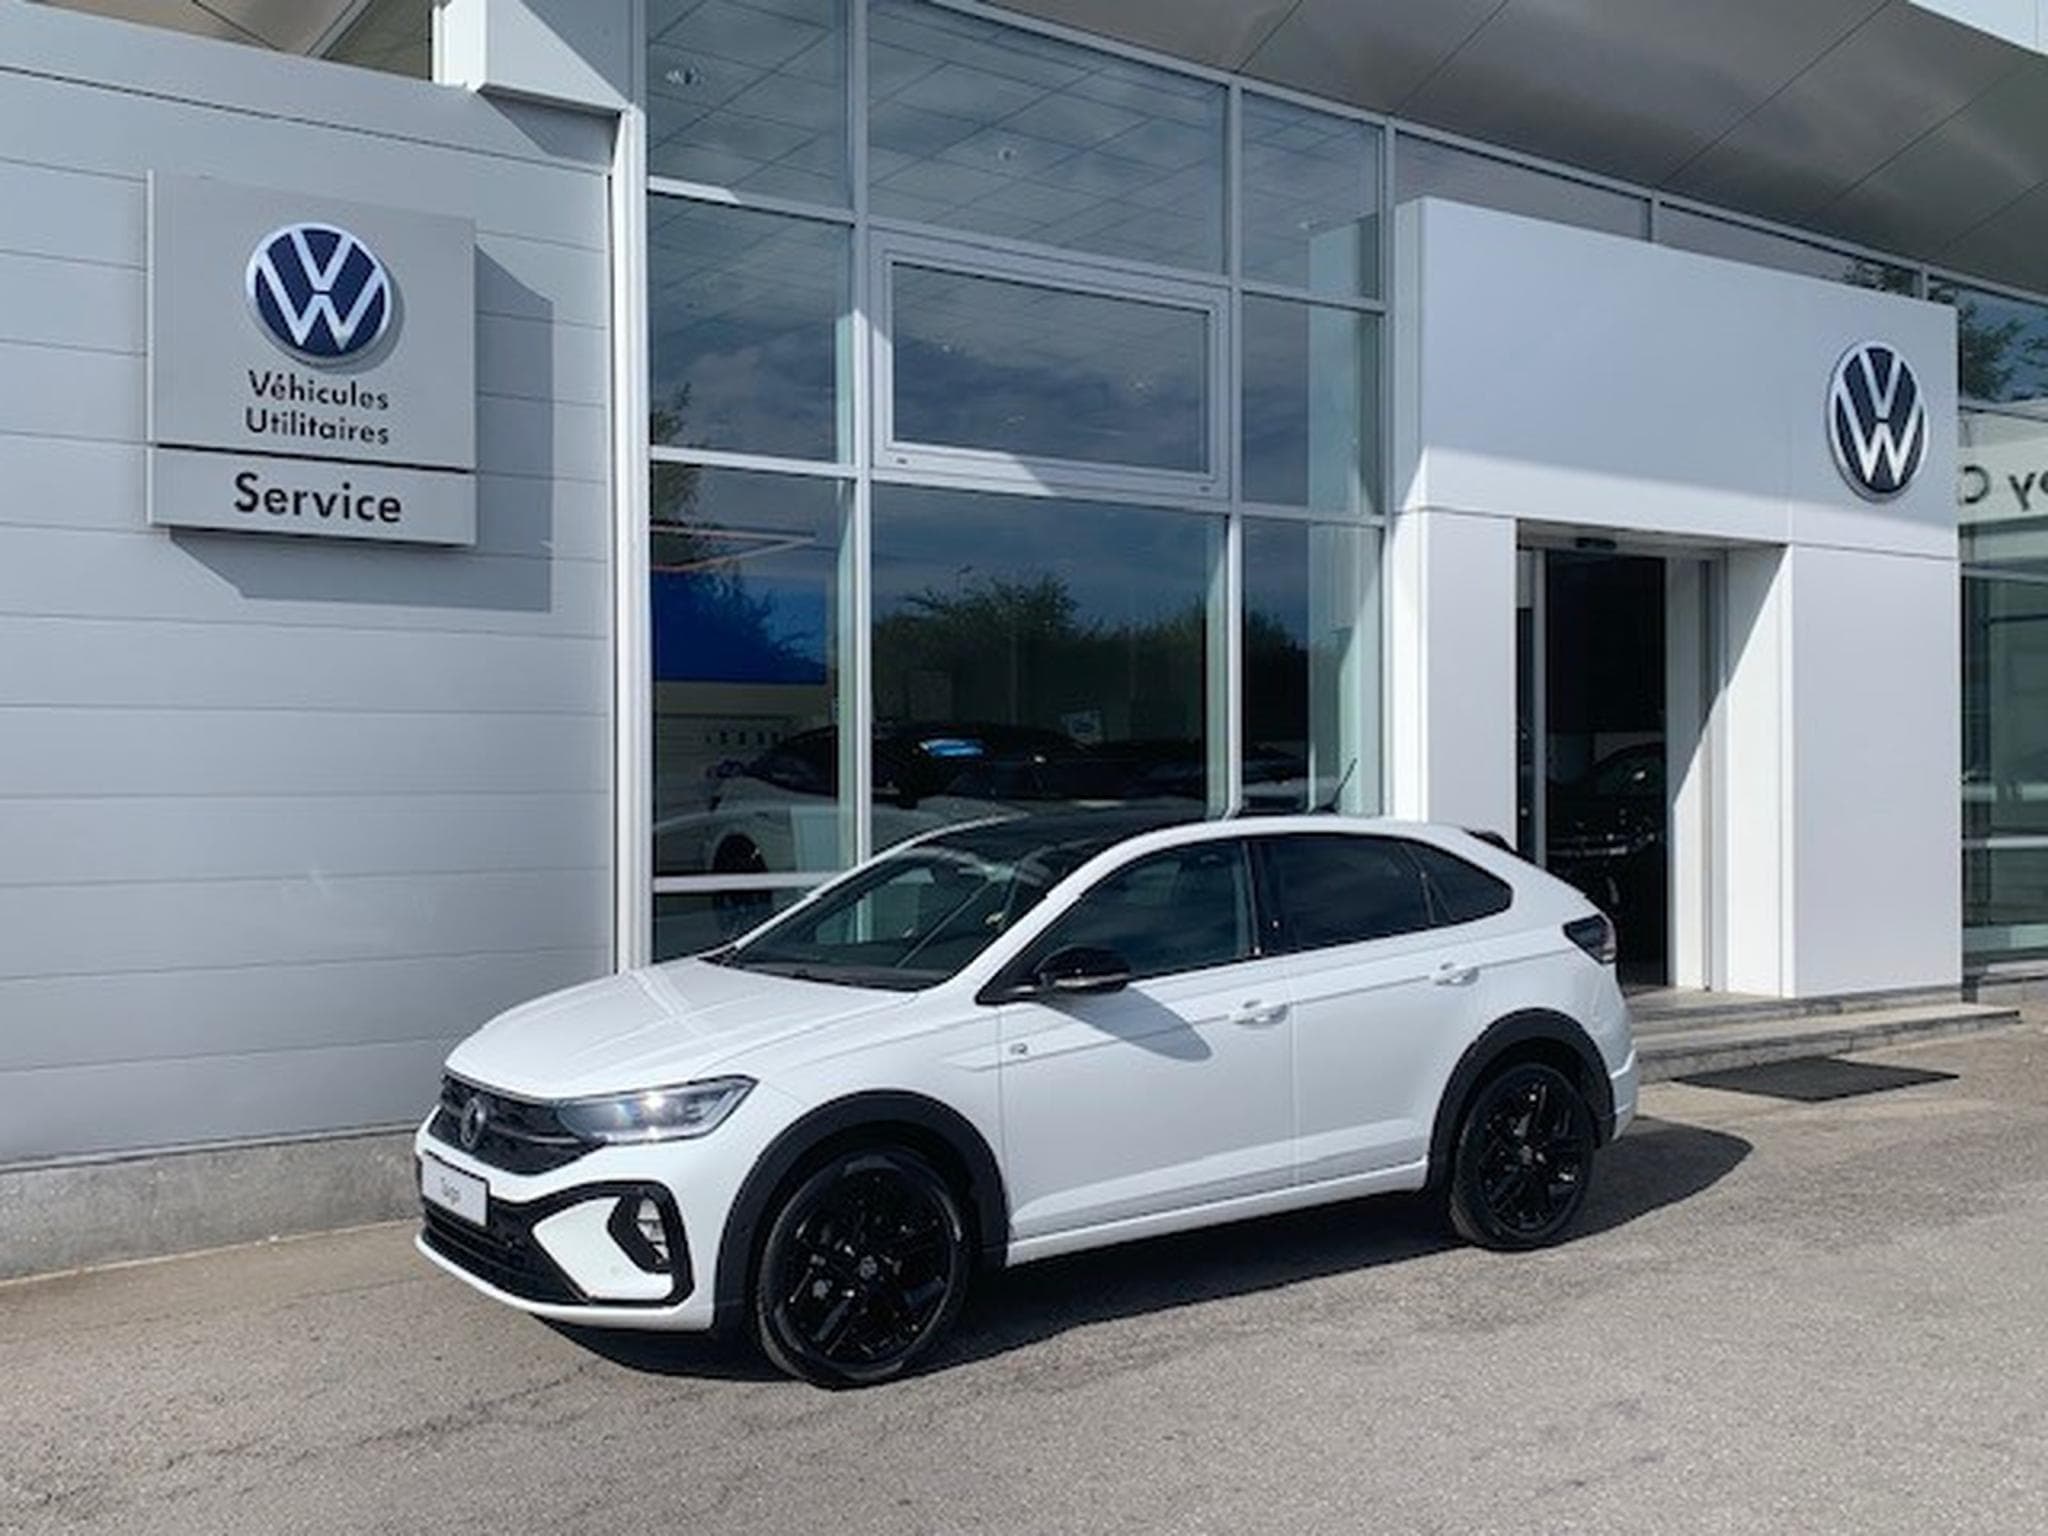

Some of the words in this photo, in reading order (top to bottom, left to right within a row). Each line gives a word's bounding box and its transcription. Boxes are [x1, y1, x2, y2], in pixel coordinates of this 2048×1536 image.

[248, 369, 389, 411] Véhicules
[245, 407, 389, 445] Utilitaires
[234, 472, 403, 523] Service
